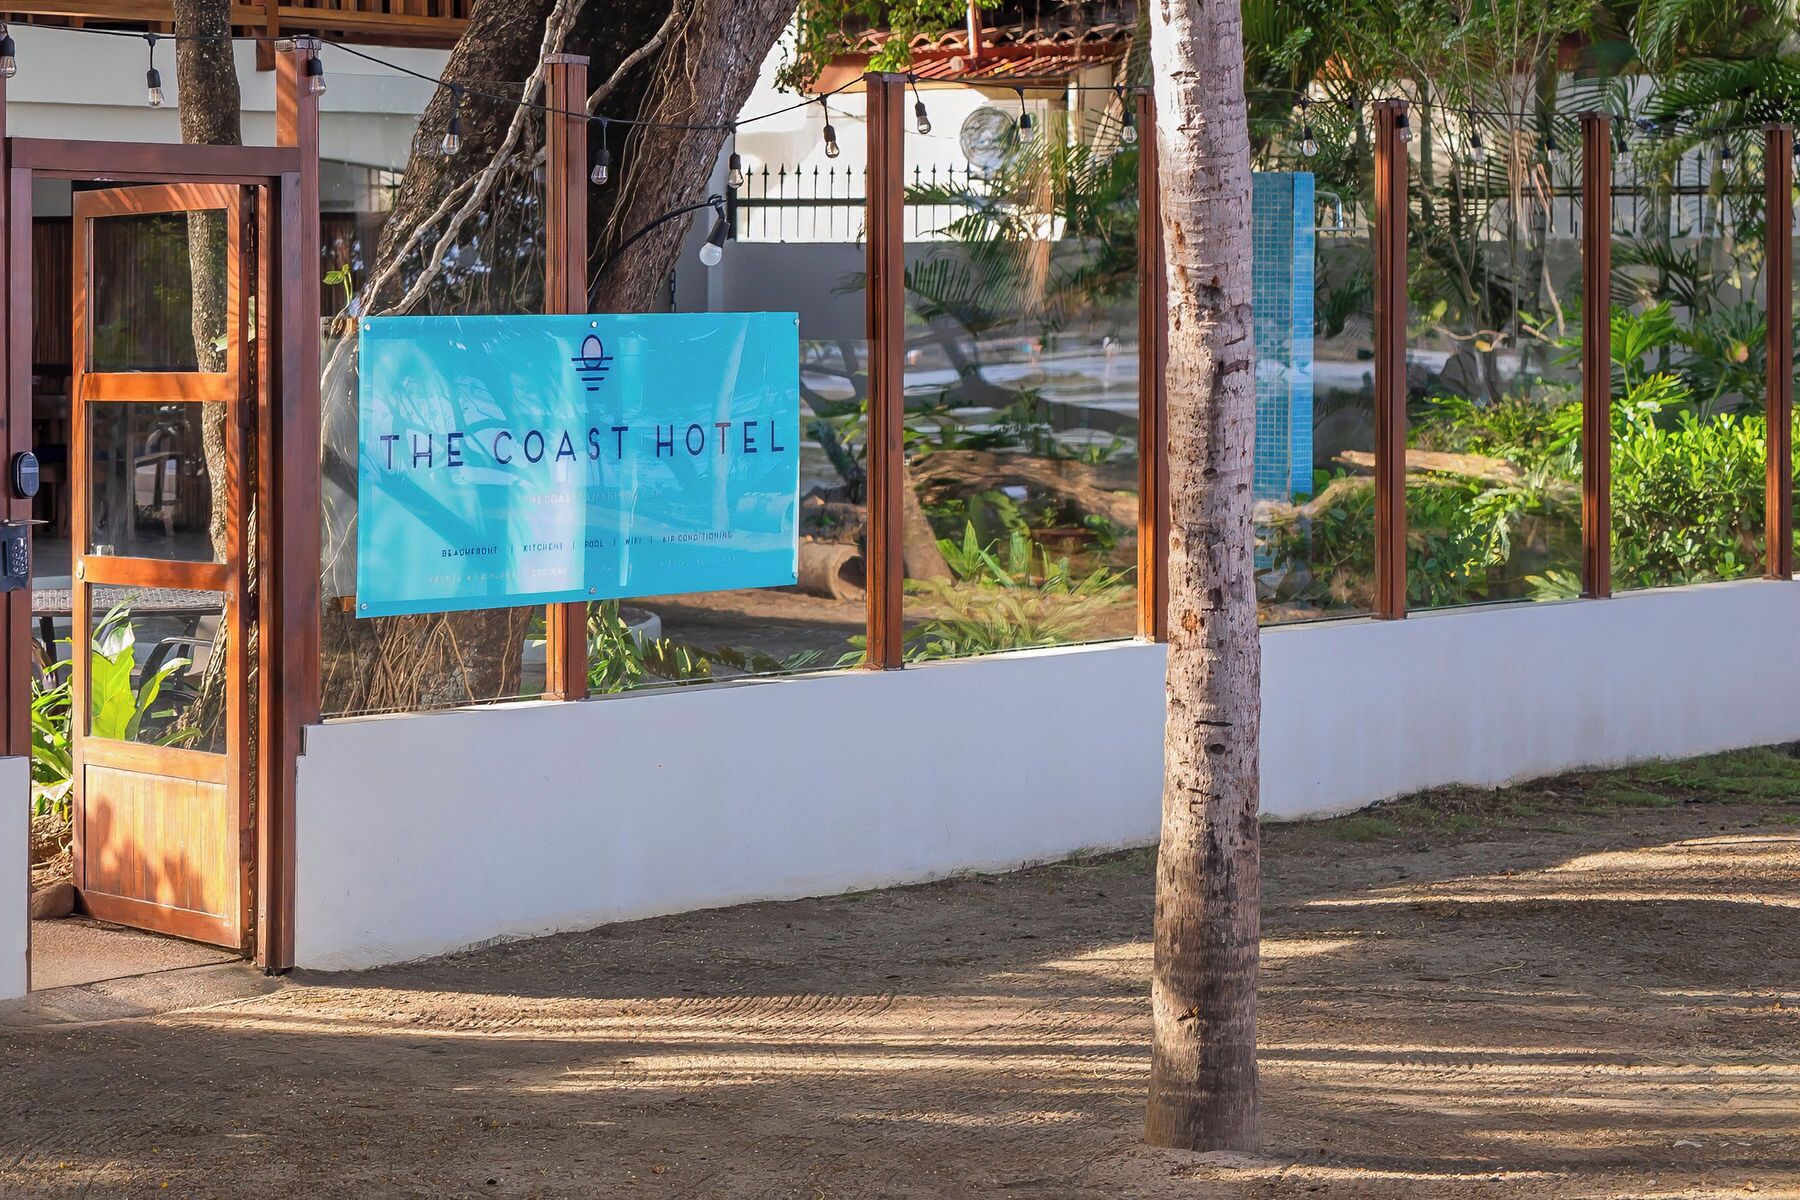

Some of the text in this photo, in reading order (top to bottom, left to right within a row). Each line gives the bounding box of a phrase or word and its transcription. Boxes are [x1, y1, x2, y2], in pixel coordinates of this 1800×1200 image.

[380, 419, 786, 470] THE COAST HOTEL
[441, 546, 498, 558] BEACHFRONT
[584, 538, 604, 548] POOL
[677, 530, 733, 543] CONDITIONING
